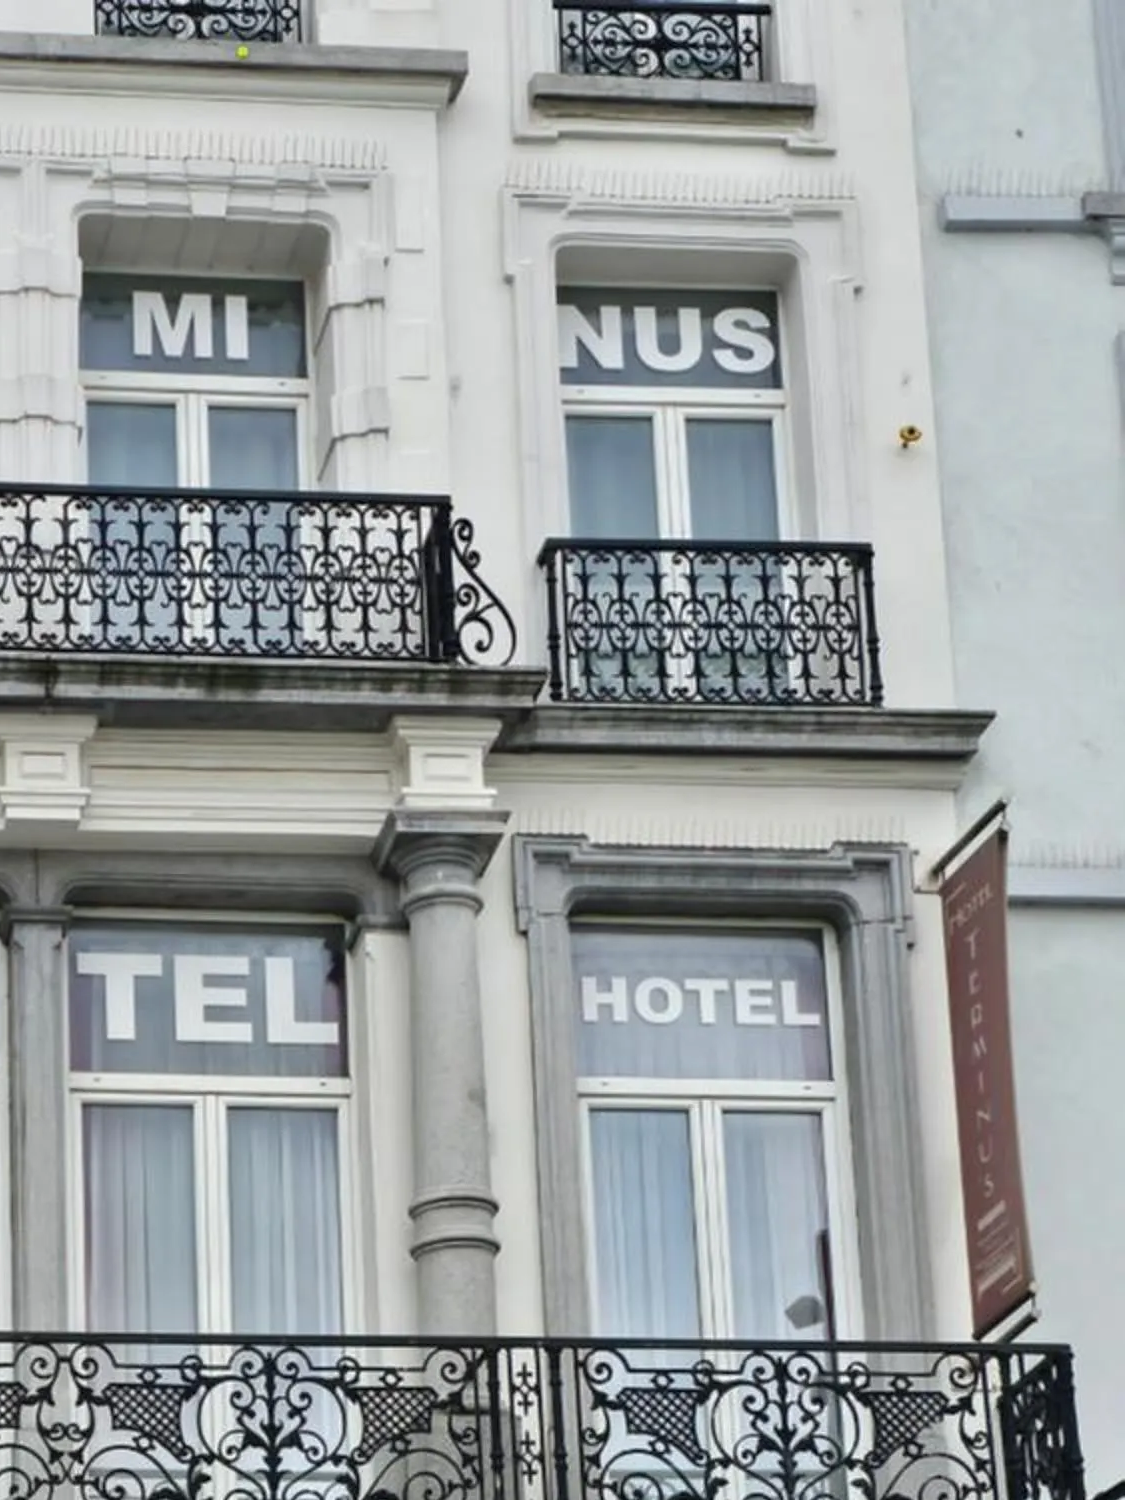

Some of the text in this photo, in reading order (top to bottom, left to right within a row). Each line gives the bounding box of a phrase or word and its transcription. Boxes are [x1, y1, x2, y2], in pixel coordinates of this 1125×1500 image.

[131, 290, 251, 361] MI
[558, 304, 776, 374] NUS
[75, 952, 340, 1046] TEL
[580, 975, 822, 1027] HOTEL
